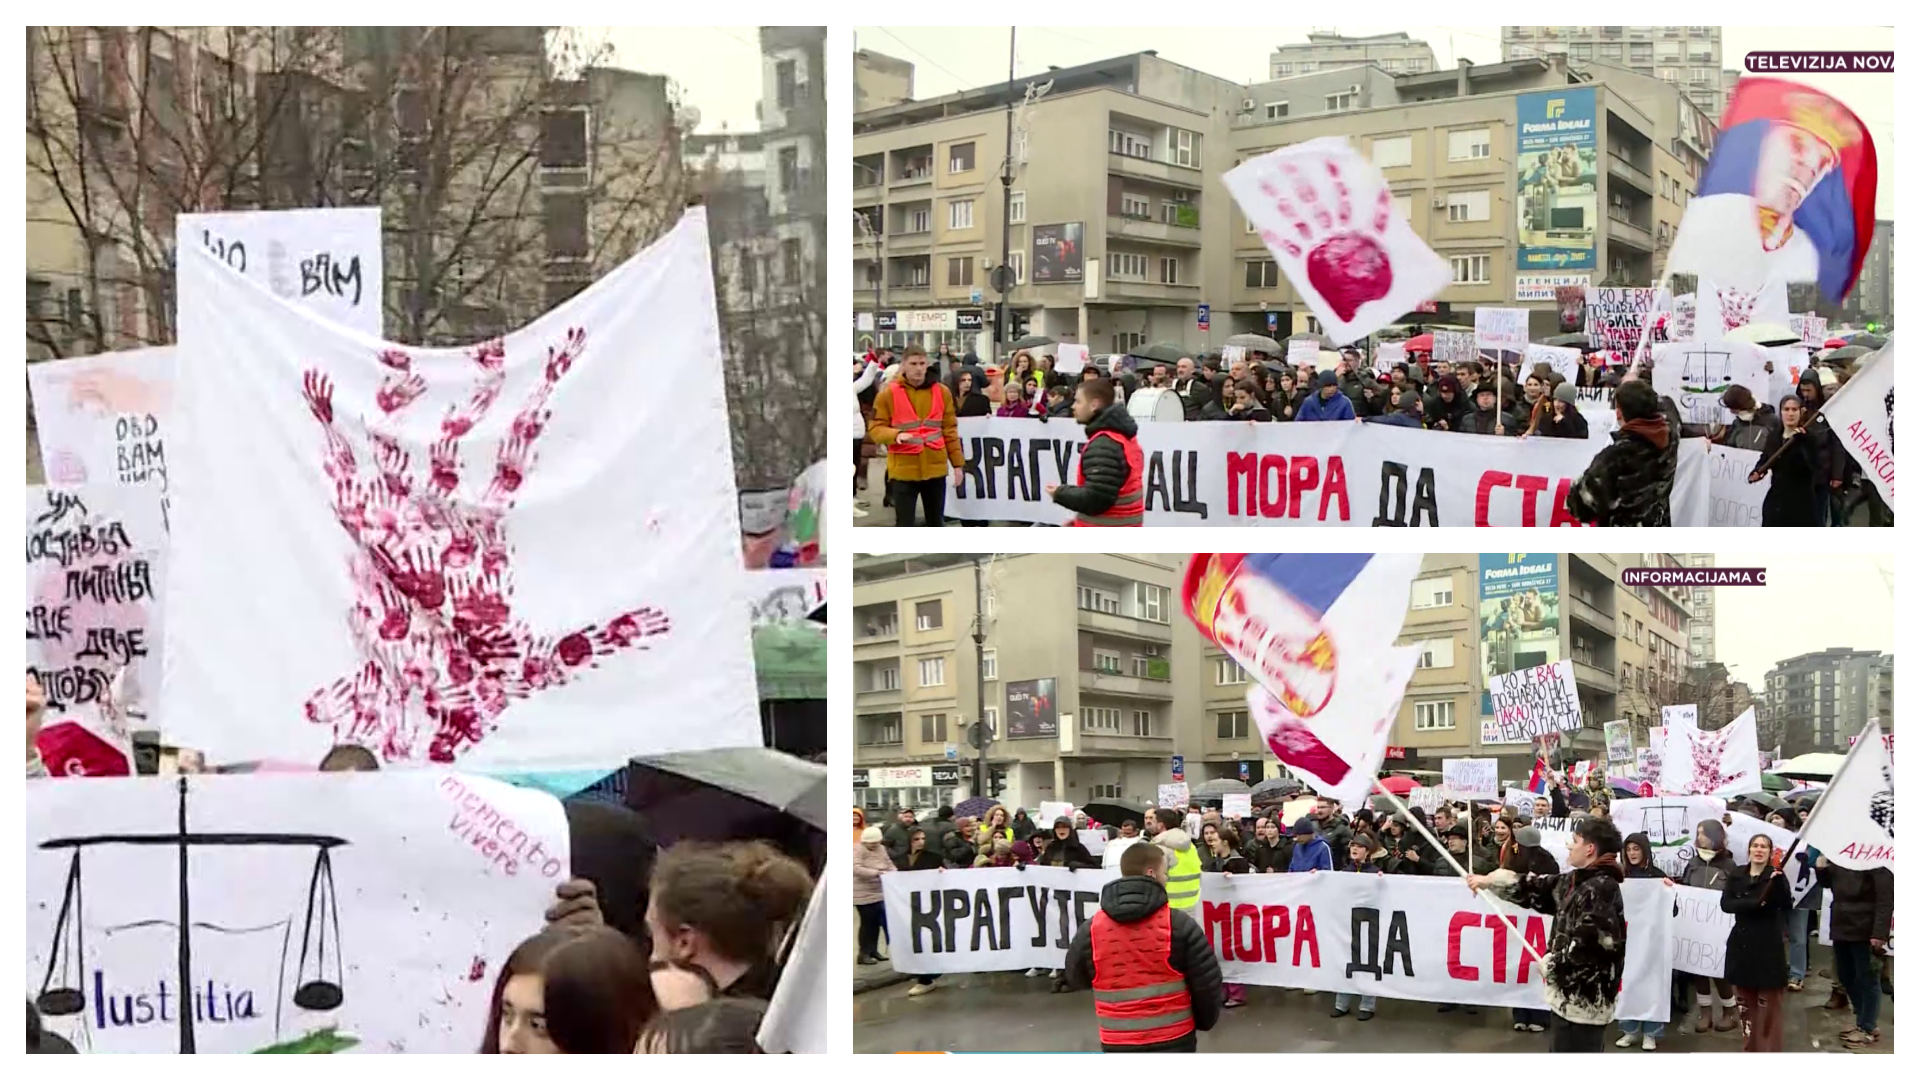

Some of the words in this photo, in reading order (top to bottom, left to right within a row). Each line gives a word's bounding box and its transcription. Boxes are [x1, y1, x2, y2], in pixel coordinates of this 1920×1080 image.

[300, 252, 362, 306] ВАМ
[1518, 276, 1588, 286] АГЕНЦИЈА
[879, 316, 896, 325] ESLA
[915, 312, 948, 322] TEMPO
[957, 315, 982, 324] TESLA
[1227, 451, 1350, 521] МОРА
[1372, 460, 1439, 527] ДА
[1485, 568, 1518, 579] FORMA
[1519, 563, 1552, 575] IDEALE
[1501, 672, 1518, 692] КО
[1522, 668, 1536, 687] ЈЕ
[1536, 662, 1562, 683] ВАС
[889, 769, 922, 778] TEMPO
[932, 771, 959, 780] TESLA
[1202, 901, 1321, 968] МОРА
[1346, 907, 1415, 981] ДА
